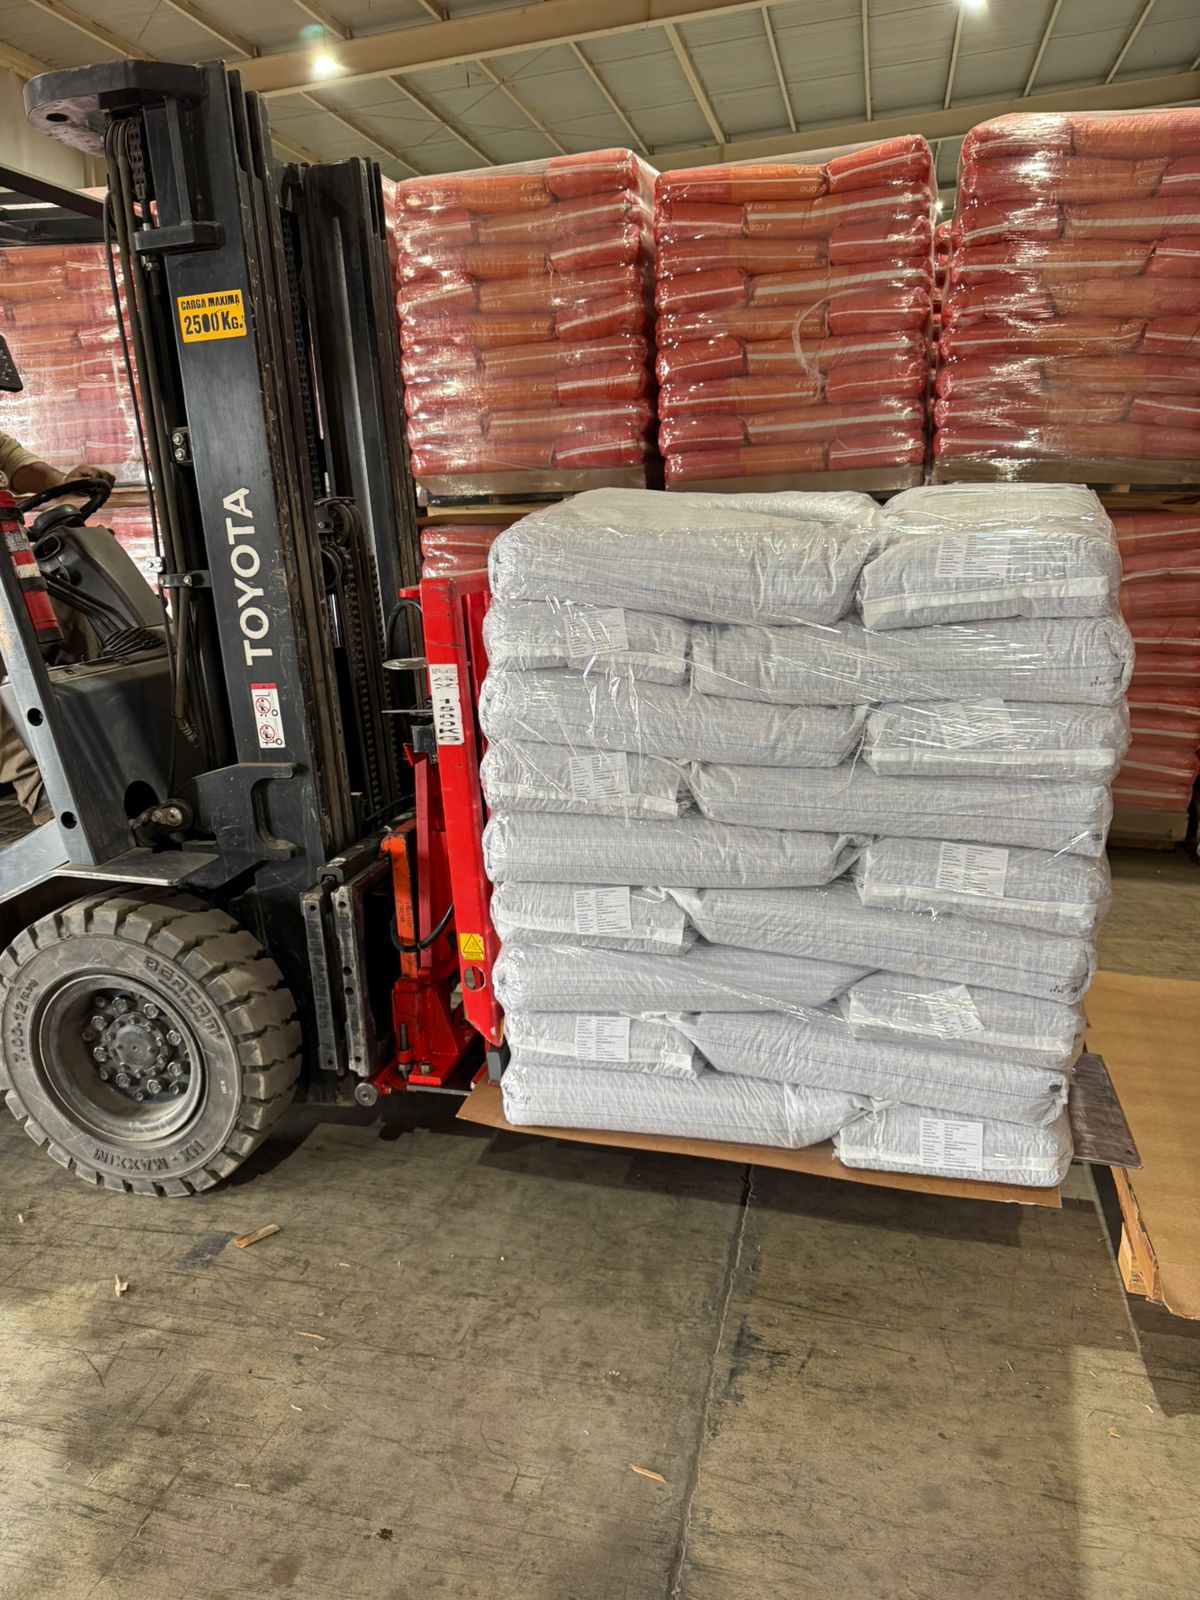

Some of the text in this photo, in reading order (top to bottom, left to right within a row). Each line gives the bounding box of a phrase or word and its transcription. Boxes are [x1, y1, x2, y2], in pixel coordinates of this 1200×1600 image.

[181, 294, 240, 310] CARGA MAXIMA
[184, 313, 219, 335] 2500
[223, 487, 274, 666] TOYOTA
